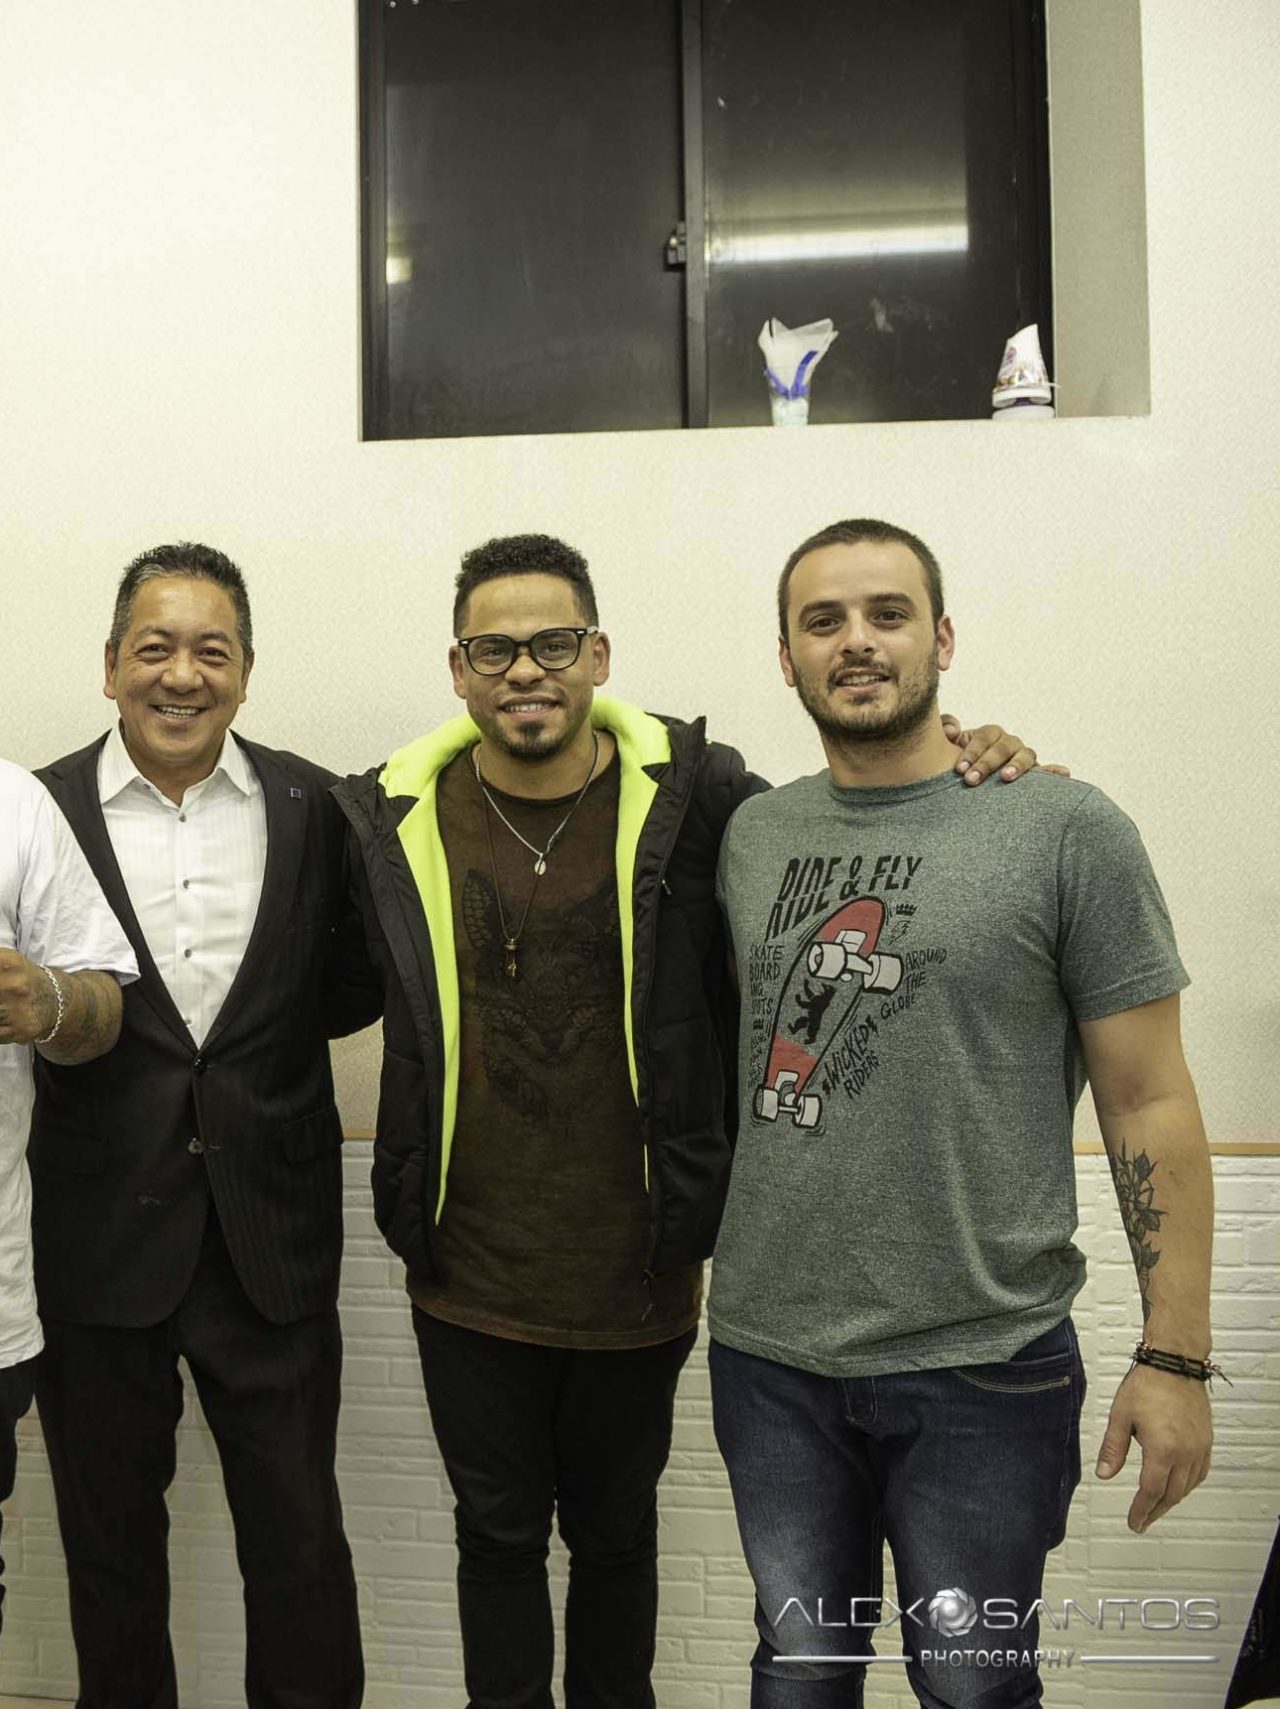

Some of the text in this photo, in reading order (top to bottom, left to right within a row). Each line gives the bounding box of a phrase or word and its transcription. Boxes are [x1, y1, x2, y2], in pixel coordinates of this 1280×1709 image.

[765, 855, 923, 943] RIDE & FLY
[905, 948, 948, 971] AROUND
[905, 971, 927, 994] THE
[880, 993, 917, 1019] GLOBE
